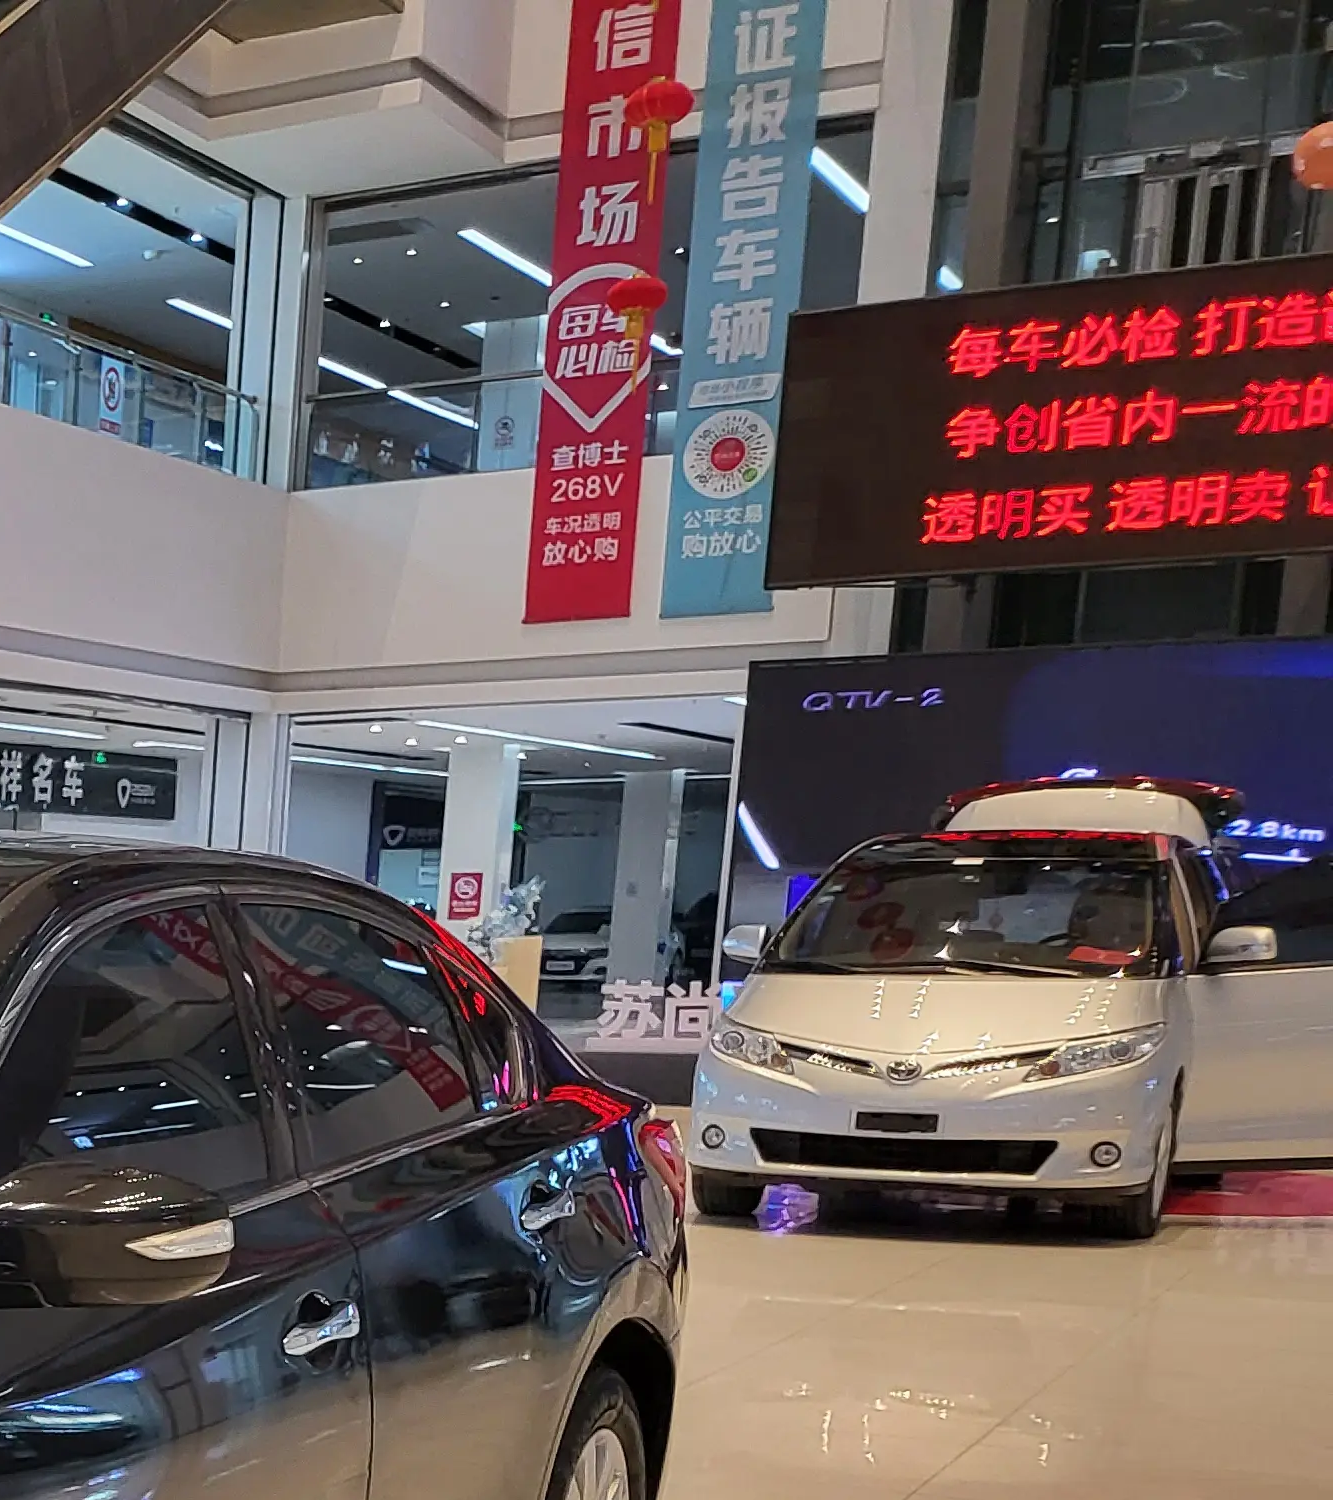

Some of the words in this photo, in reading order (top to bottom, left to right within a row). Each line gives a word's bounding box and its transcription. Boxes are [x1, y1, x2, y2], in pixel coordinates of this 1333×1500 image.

[707, 4, 799, 365] 证报告车辆
[946, 305, 1182, 378] 每车必检
[1190, 289, 1333, 358] 打造
[550, 440, 628, 471] 查博士
[550, 473, 624, 502] 268V
[683, 503, 763, 528] 公平交易
[920, 483, 1093, 544] 透明买
[1105, 467, 1292, 533] 透明卖
[544, 511, 622, 535] 车况透明
[542, 537, 620, 566] 放心购
[681, 529, 762, 559] 购放心
[1223, 818, 1326, 843] 2.8km
[597, 978, 722, 1039] 苏尚
